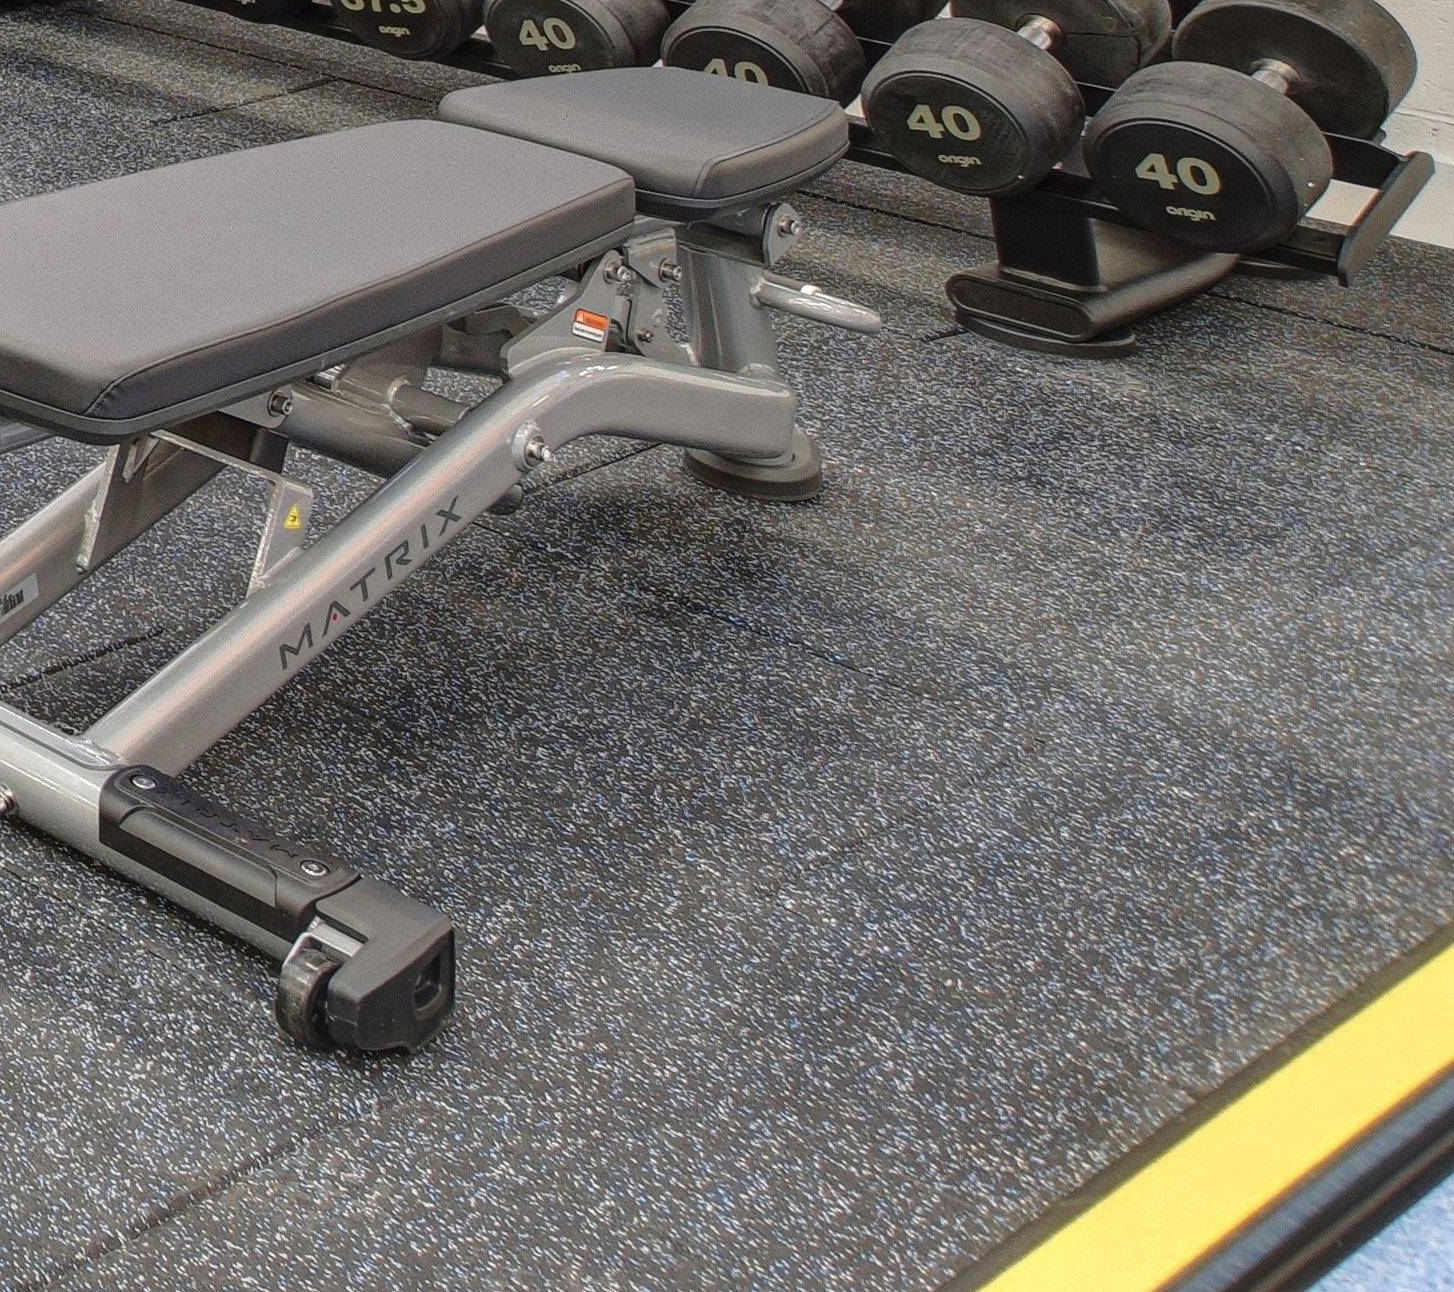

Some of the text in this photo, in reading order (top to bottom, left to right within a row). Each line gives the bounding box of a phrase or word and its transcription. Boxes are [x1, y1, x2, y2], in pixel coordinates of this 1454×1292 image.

[519, 18, 575, 50] 40
[907, 105, 980, 140] 40
[937, 154, 982, 168] origin
[1135, 153, 1221, 194] 40
[1165, 205, 1216, 222] origin
[277, 493, 467, 672] MATRIX
